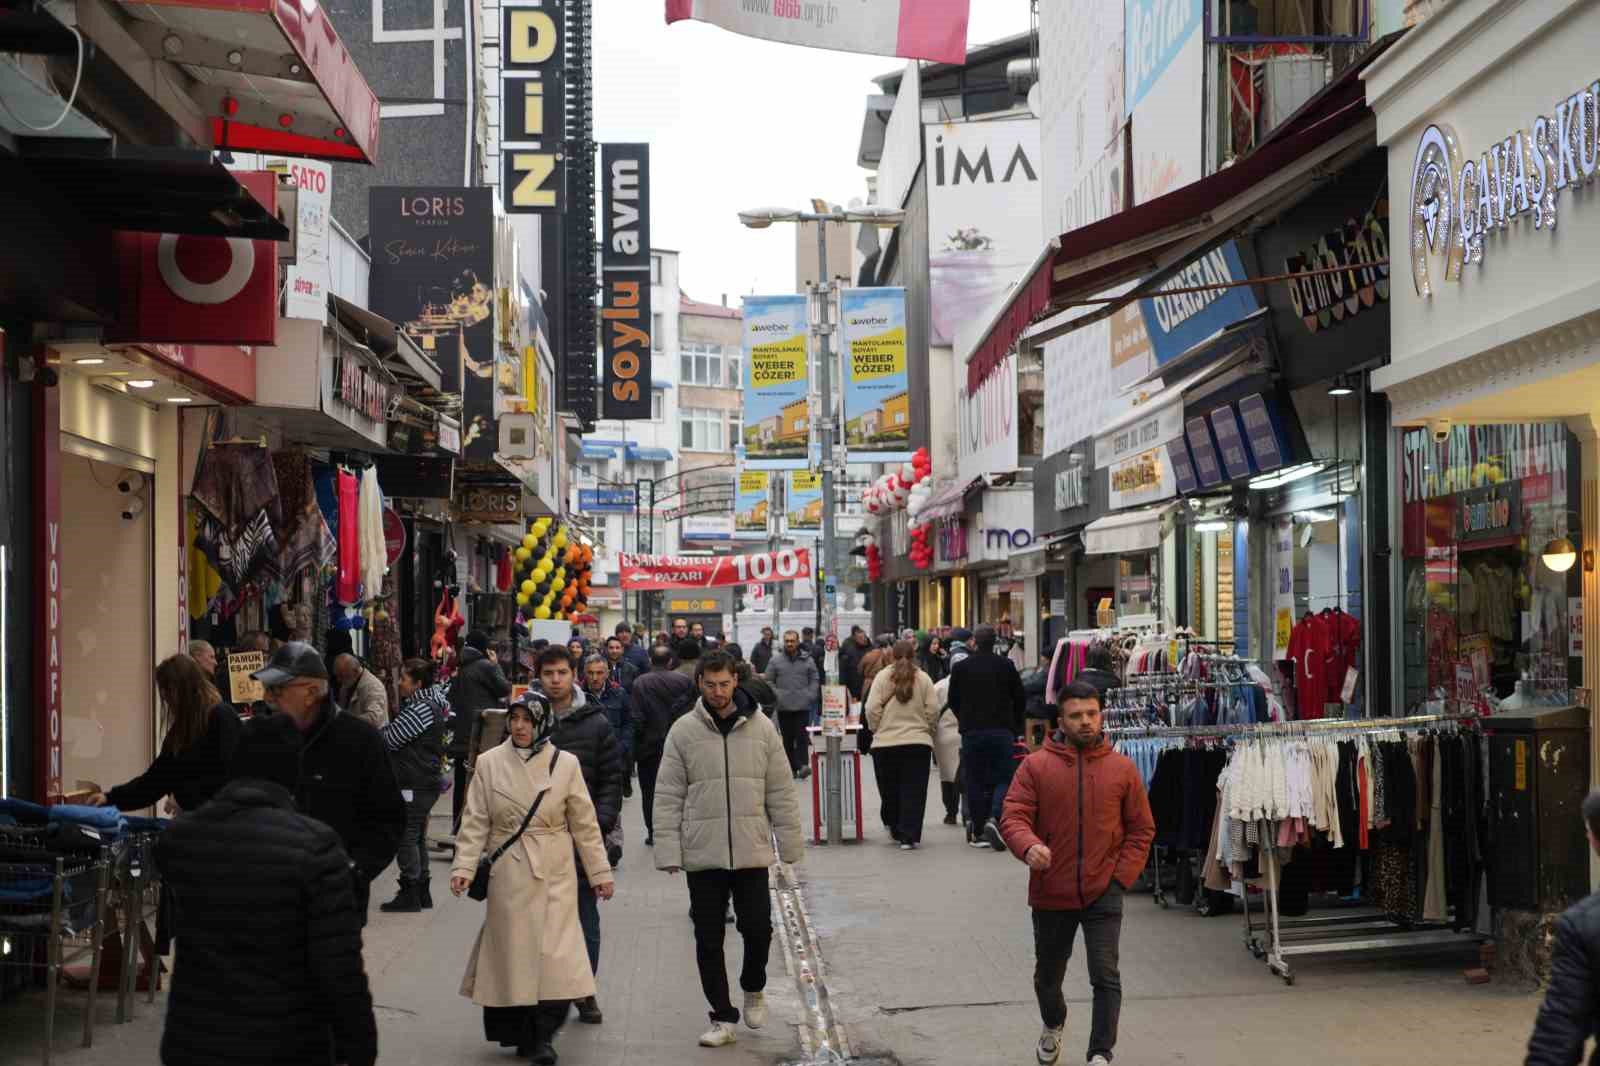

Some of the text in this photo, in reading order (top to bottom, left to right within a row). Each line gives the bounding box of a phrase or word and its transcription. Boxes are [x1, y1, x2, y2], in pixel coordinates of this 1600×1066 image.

[1459, 115, 1548, 265] ÇAVAŞ
[401, 196, 465, 216] LORIS
[602, 159, 650, 401] soylu avm
[753, 360, 794, 369] WEBER
[854, 354, 894, 363] WEBER
[753, 369, 796, 380] ÇÖZER!
[854, 363, 896, 375] ÇÖZER!
[462, 494, 518, 513] LORIS
[655, 571, 703, 583] PAZARI
[48, 522, 59, 790] VODAFON
[229, 653, 262, 665] PAMUK
